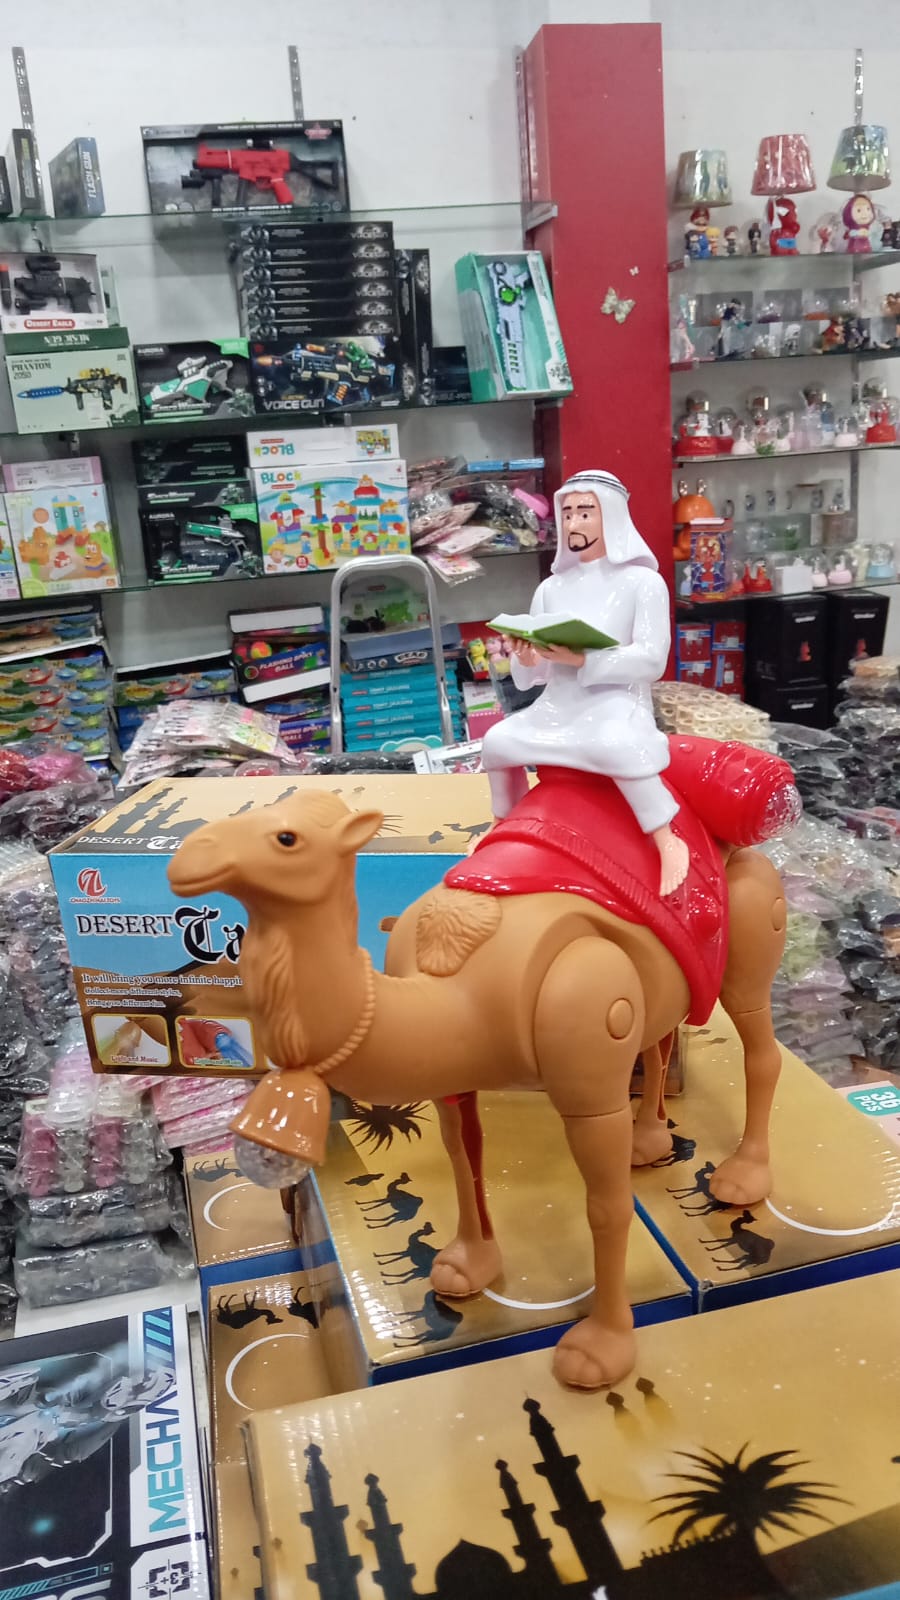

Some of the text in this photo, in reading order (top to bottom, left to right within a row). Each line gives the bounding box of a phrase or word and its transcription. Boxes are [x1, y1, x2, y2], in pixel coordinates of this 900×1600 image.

[11, 361, 52, 371] PHANTOM
[263, 398, 325, 411] VOICE GUN
[77, 836, 148, 845] DESERT
[76, 915, 173, 936] DESERT
[82, 973, 91, 983] It
[92, 973, 110, 983] will
[110, 973, 134, 985] bring
[134, 976, 154, 985] you
[155, 976, 178, 984] more
[179, 974, 213, 984] infinite
